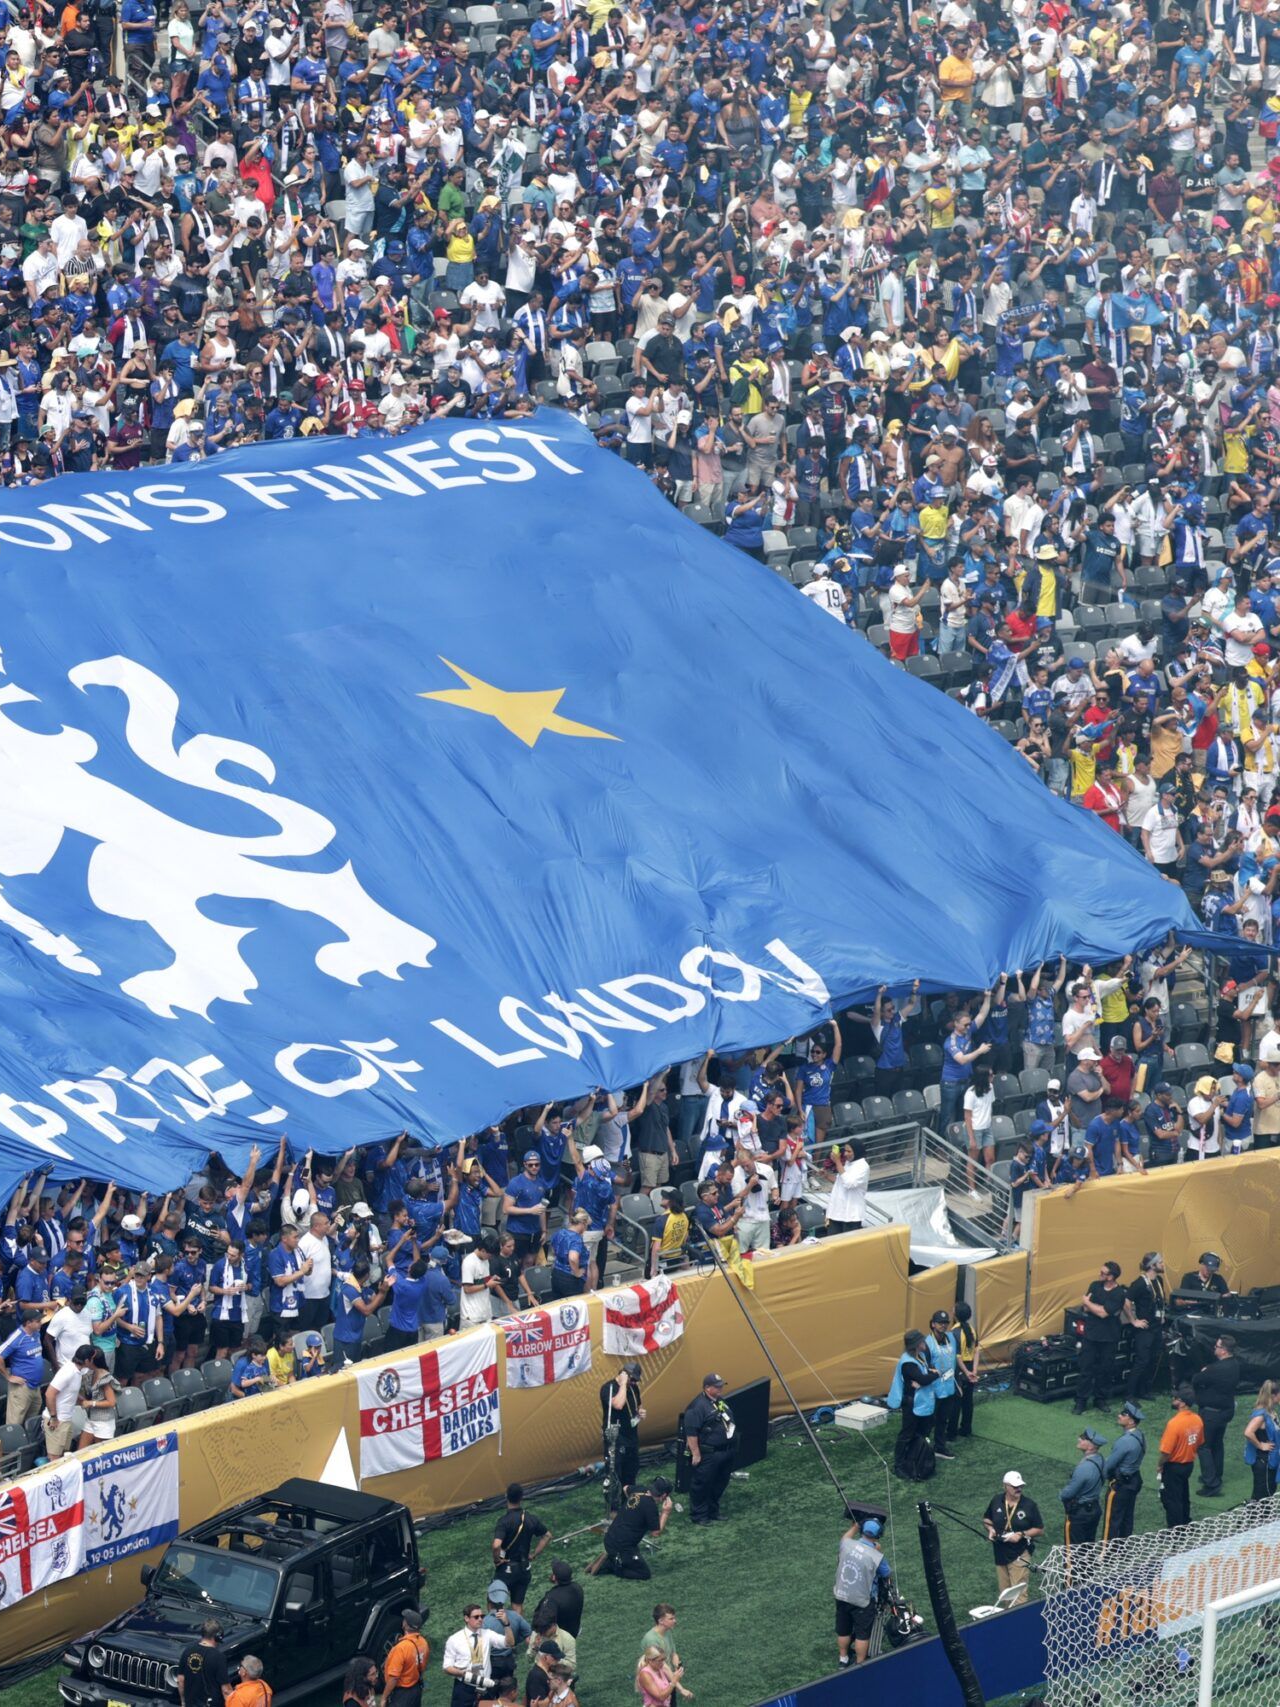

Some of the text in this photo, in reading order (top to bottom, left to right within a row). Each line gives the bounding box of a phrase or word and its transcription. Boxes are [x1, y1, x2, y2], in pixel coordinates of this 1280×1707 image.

[220, 426, 583, 510] FINEST
[825, 588, 840, 608] 19
[275, 1038, 424, 1098] OF
[429, 938, 831, 1068] LONDON
[512, 1330, 587, 1356] BARROW BLUES
[372, 1371, 490, 1434] CHELSEA
[451, 1415, 494, 1451] BLUES
[86, 1464, 94, 1477] &
[95, 1459, 112, 1474] Mrs
[112, 1446, 145, 1466] O'Neill
[116, 1536, 150, 1556] London
